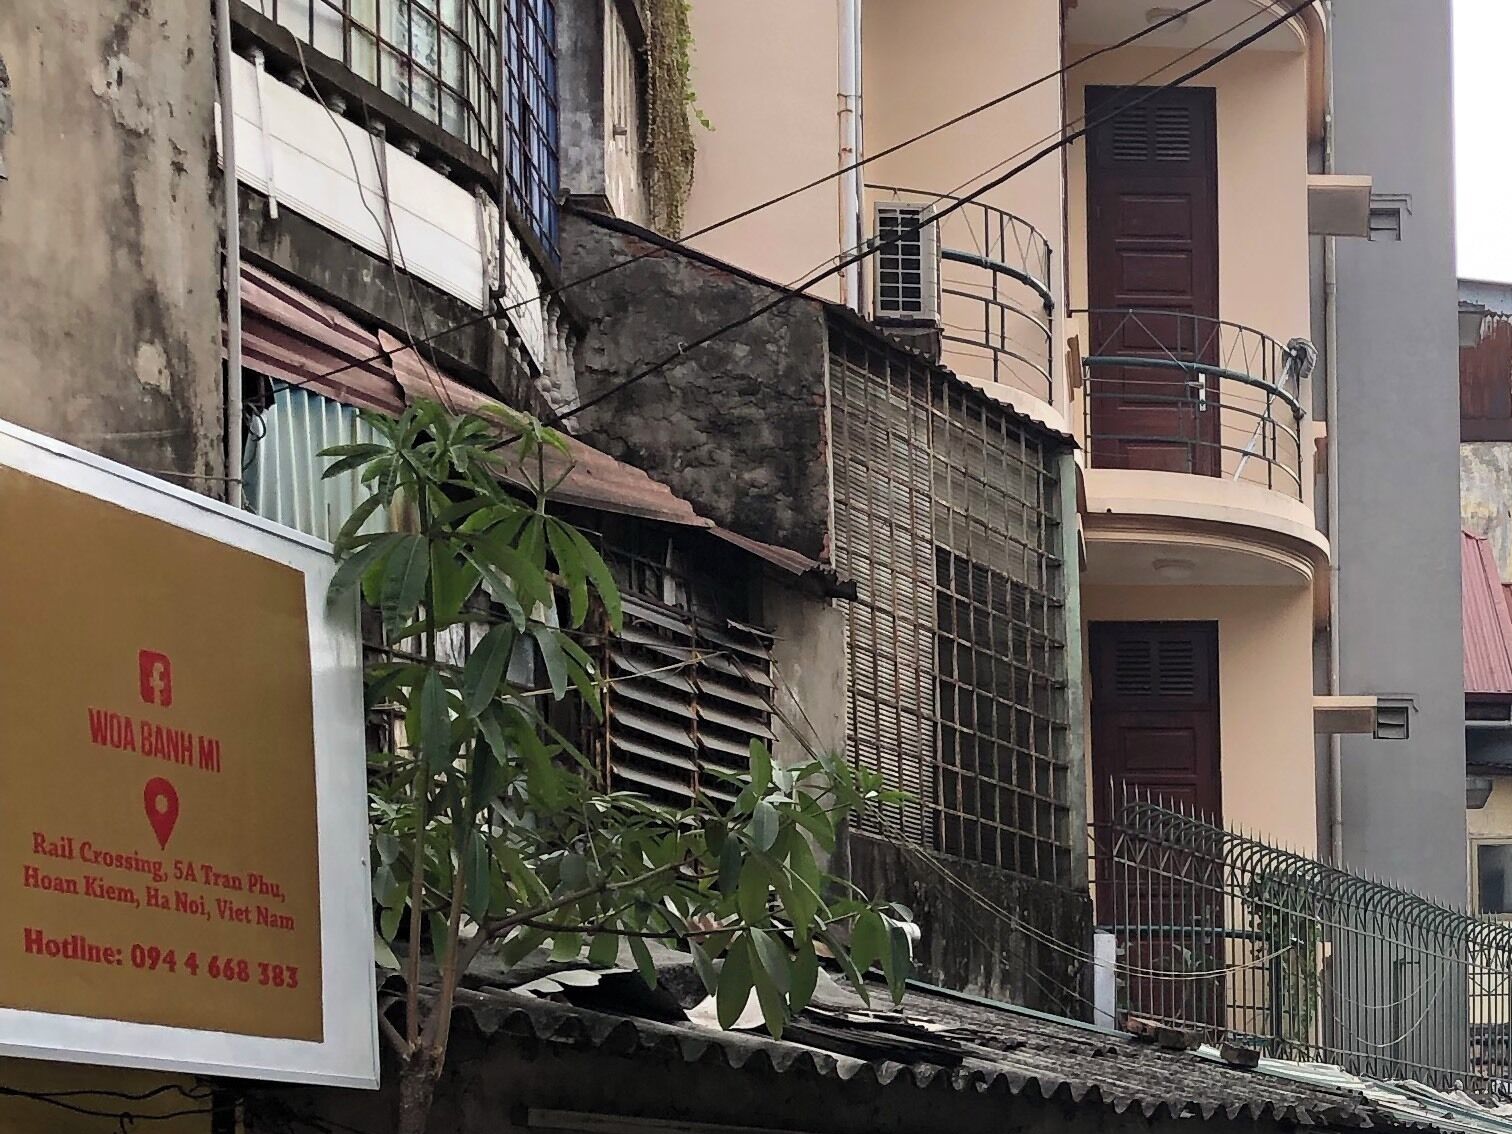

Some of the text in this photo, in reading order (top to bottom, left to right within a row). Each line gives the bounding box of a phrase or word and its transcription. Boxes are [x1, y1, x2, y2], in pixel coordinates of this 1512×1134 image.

[88, 707, 220, 773] WOA BANH MI
[23, 865, 294, 930] Hoan Kiem, Ha Noi, Viet Nam
[33, 832, 285, 902] Rail Crossing, 5A Tran Phu,
[24, 928, 298, 988] Hotline: 094 4 668 383
